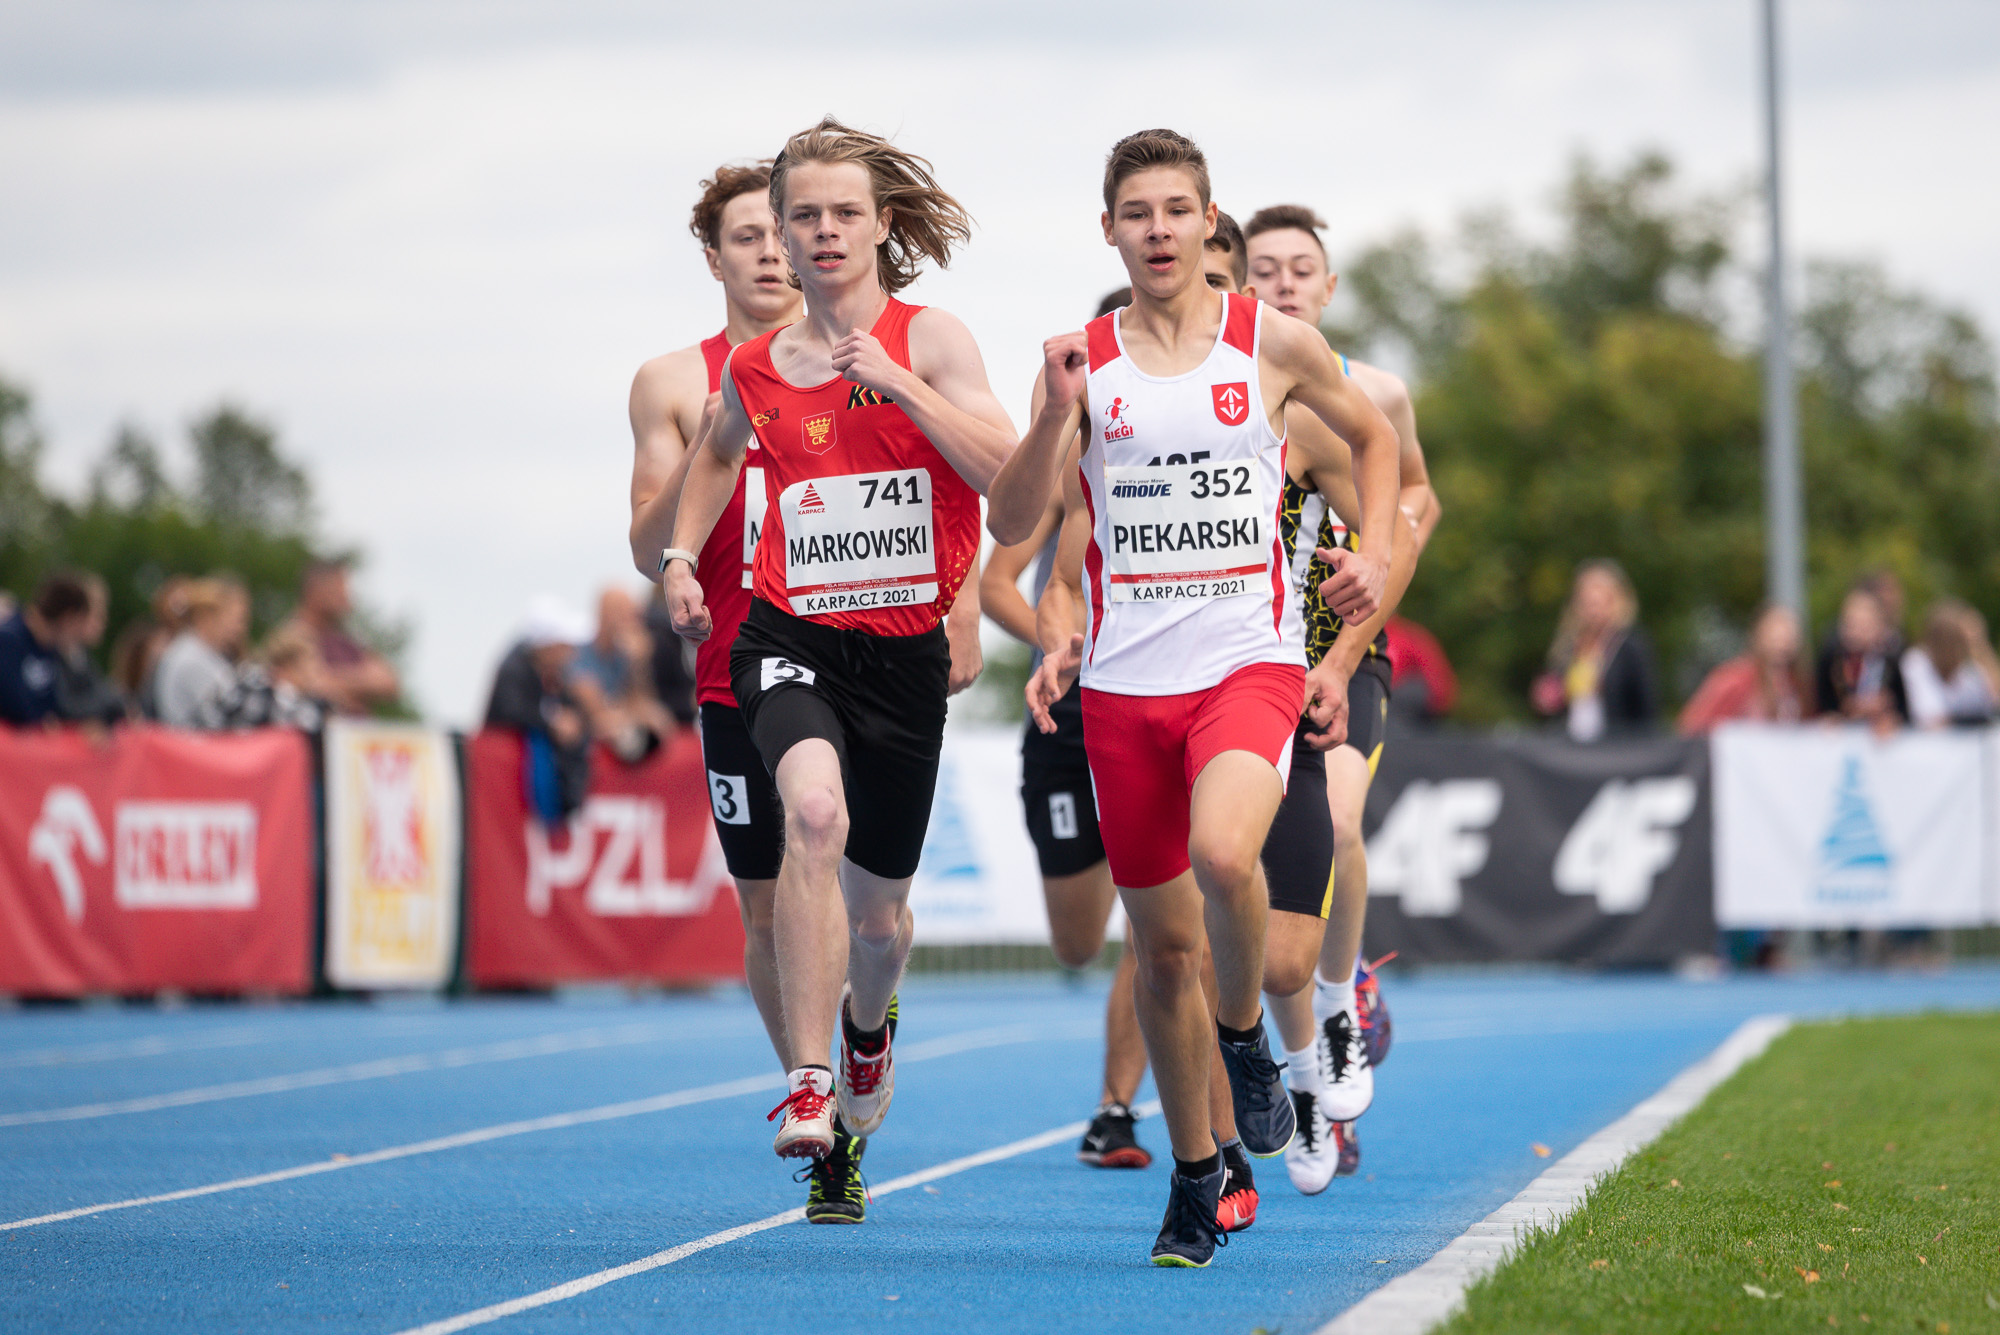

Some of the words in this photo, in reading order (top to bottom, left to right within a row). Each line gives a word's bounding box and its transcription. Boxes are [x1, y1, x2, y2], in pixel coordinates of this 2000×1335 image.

[811, 435, 827, 446] CK
[1104, 425, 1133, 441] BIEGI
[858, 475, 922, 509] 741
[1111, 483, 1172, 498] 4MOVE
[1190, 466, 1252, 499] 352
[797, 507, 826, 516] KARPACZ
[789, 525, 927, 567] MARKOWSKI
[1113, 516, 1259, 554] PIEKARSKI
[806, 592, 878, 612] KARPACZ
[882, 588, 917, 604] 2021
[1133, 584, 1207, 601] KARPACZ
[1212, 579, 1245, 597] 2021
[773, 659, 804, 681] 5
[715, 778, 738, 820] 3
[1552, 773, 1697, 914] 4F
